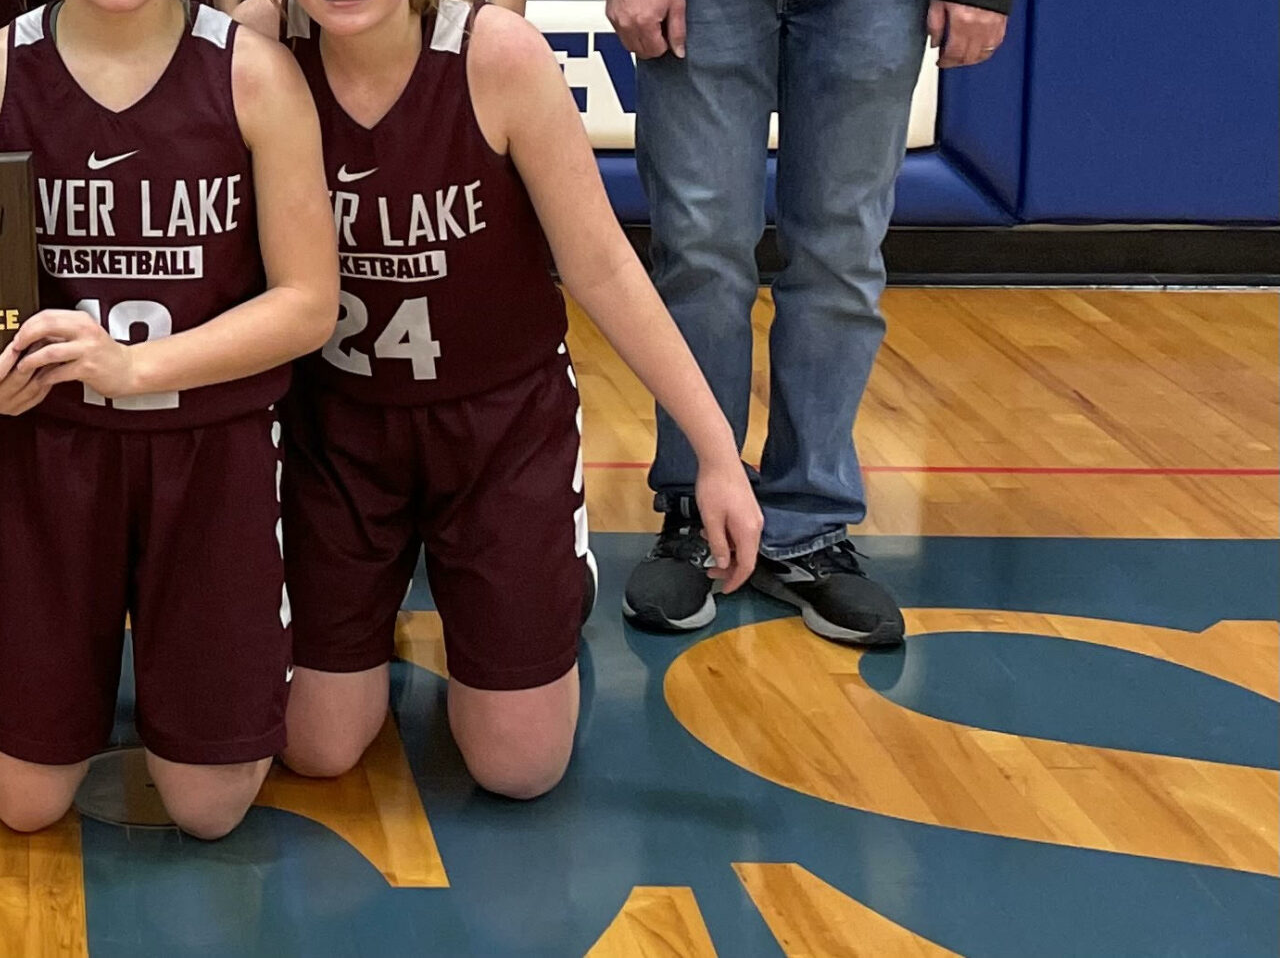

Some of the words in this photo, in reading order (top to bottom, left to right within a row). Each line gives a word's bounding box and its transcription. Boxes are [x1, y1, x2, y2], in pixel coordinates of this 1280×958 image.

[35, 177, 116, 236] VER
[140, 174, 241, 237] LAKE
[378, 179, 487, 246] LAKE
[43, 248, 195, 275] BASKETBALL
[340, 255, 439, 279] KETBALL
[321, 290, 441, 381] 24
